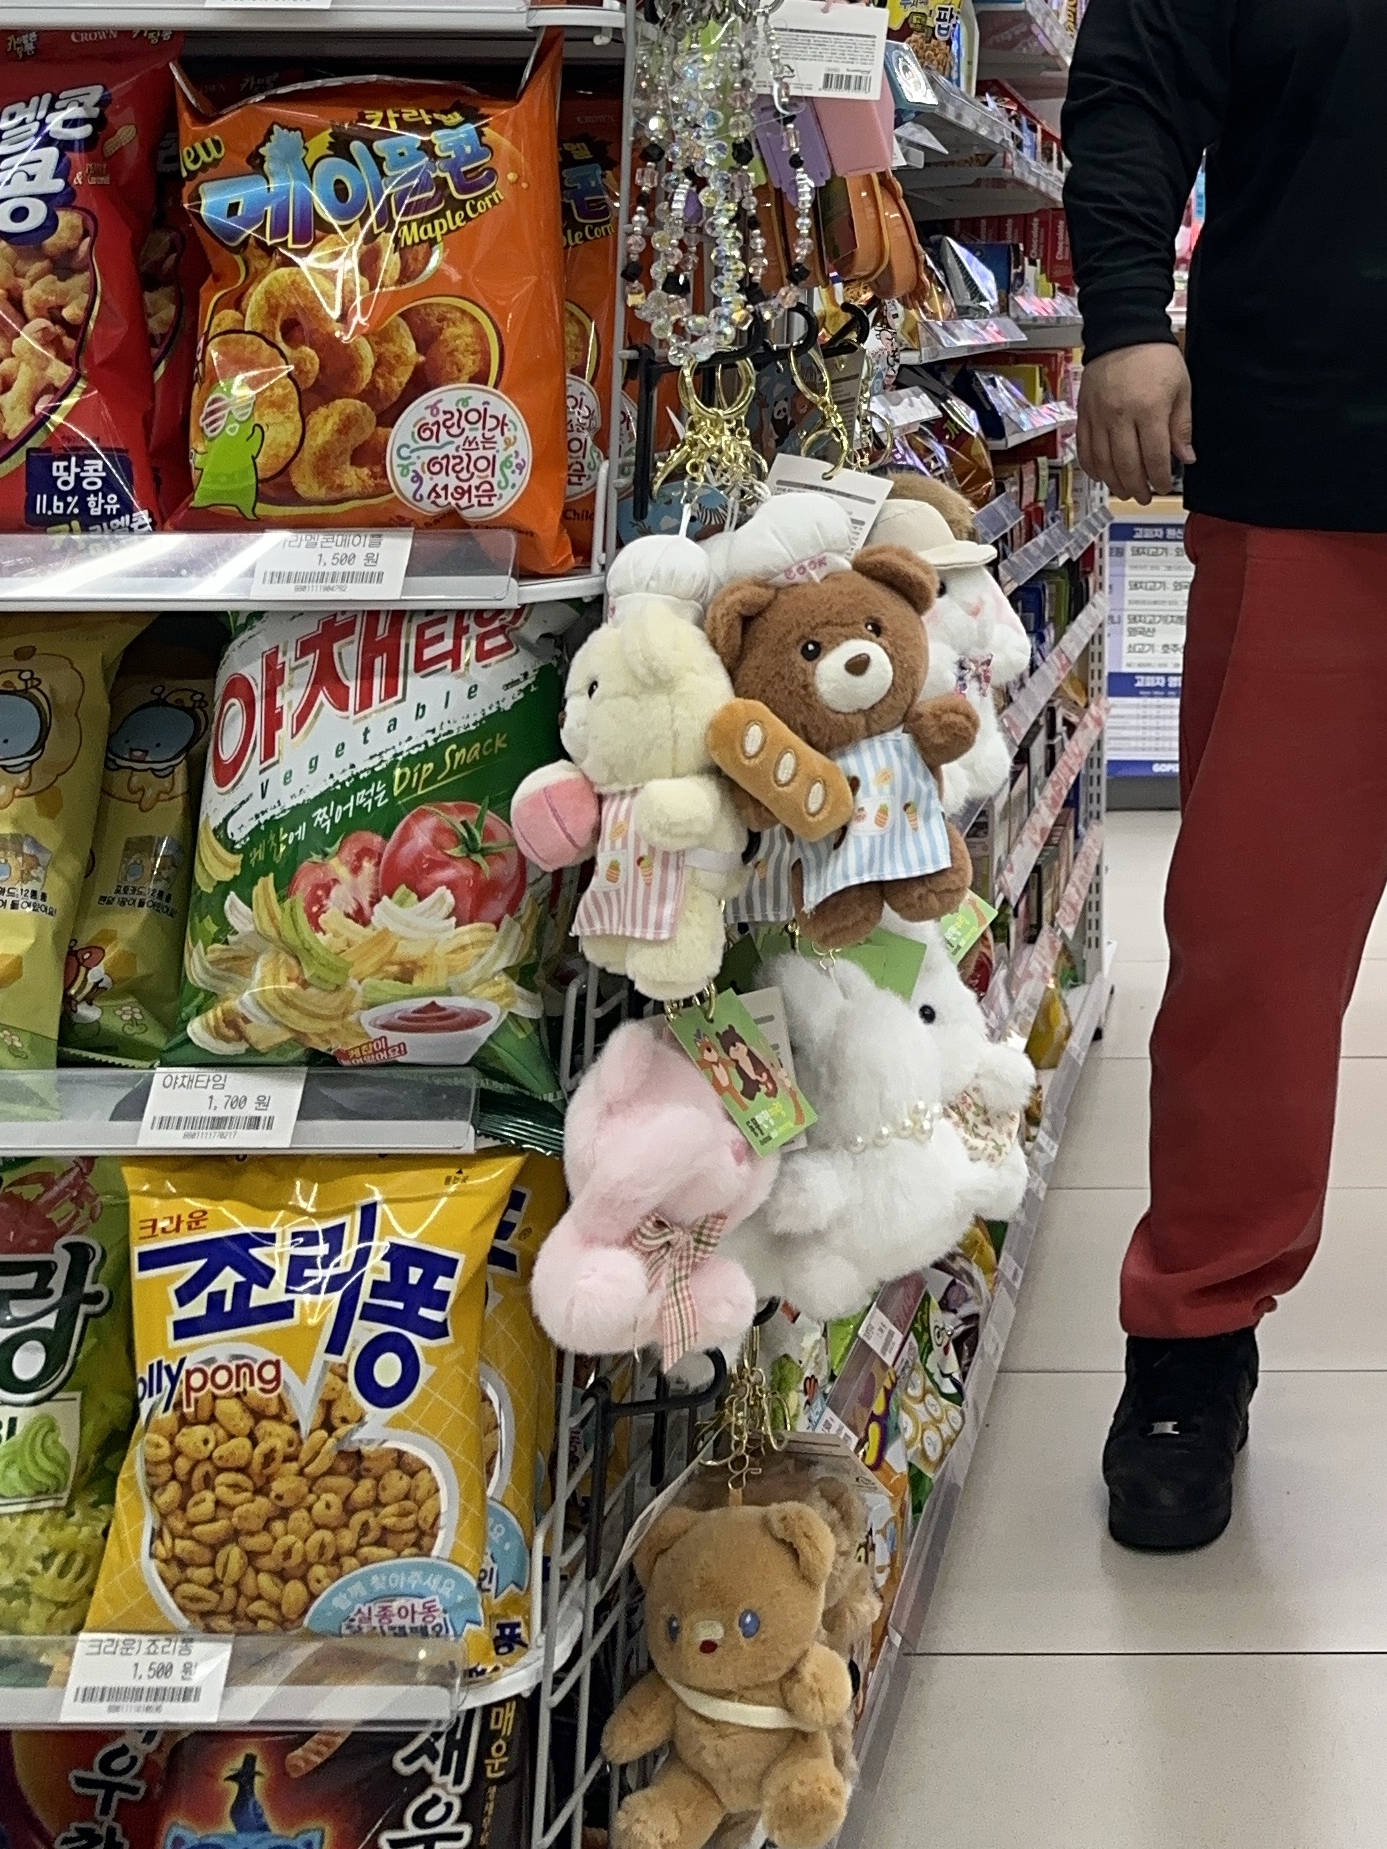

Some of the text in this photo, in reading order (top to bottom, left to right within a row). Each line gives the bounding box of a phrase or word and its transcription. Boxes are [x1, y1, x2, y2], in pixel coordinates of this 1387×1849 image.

[199, 123, 500, 250] 메이플콘
[399, 190, 505, 248] Maple Corn
[417, 404, 507, 443] 어린이가
[462, 435, 498, 452] 쓰는
[52, 456, 107, 492] 땅콩
[426, 453, 497, 482] 어린이
[36, 492, 121, 516] 11.6% 함유
[427, 480, 497, 512] 선언문
[282, 533, 384, 549] 라멜콘메이플
[316, 552, 379, 568] 1,500 원
[312, 780, 389, 836] 찍어먹는
[393, 760, 434, 797] Dip
[437, 730, 508, 782] Snack
[162, 1074, 228, 1091] 야채타임
[207, 1095, 271, 1112] 1,700 원
[138, 1209, 209, 1240] 크라운
[136, 1200, 463, 1410] 죠리퐁
[138, 1357, 282, 1415] ollypong
[352, 1599, 441, 1626] 실종아동
[132, 1661, 174, 1681] 1,500
